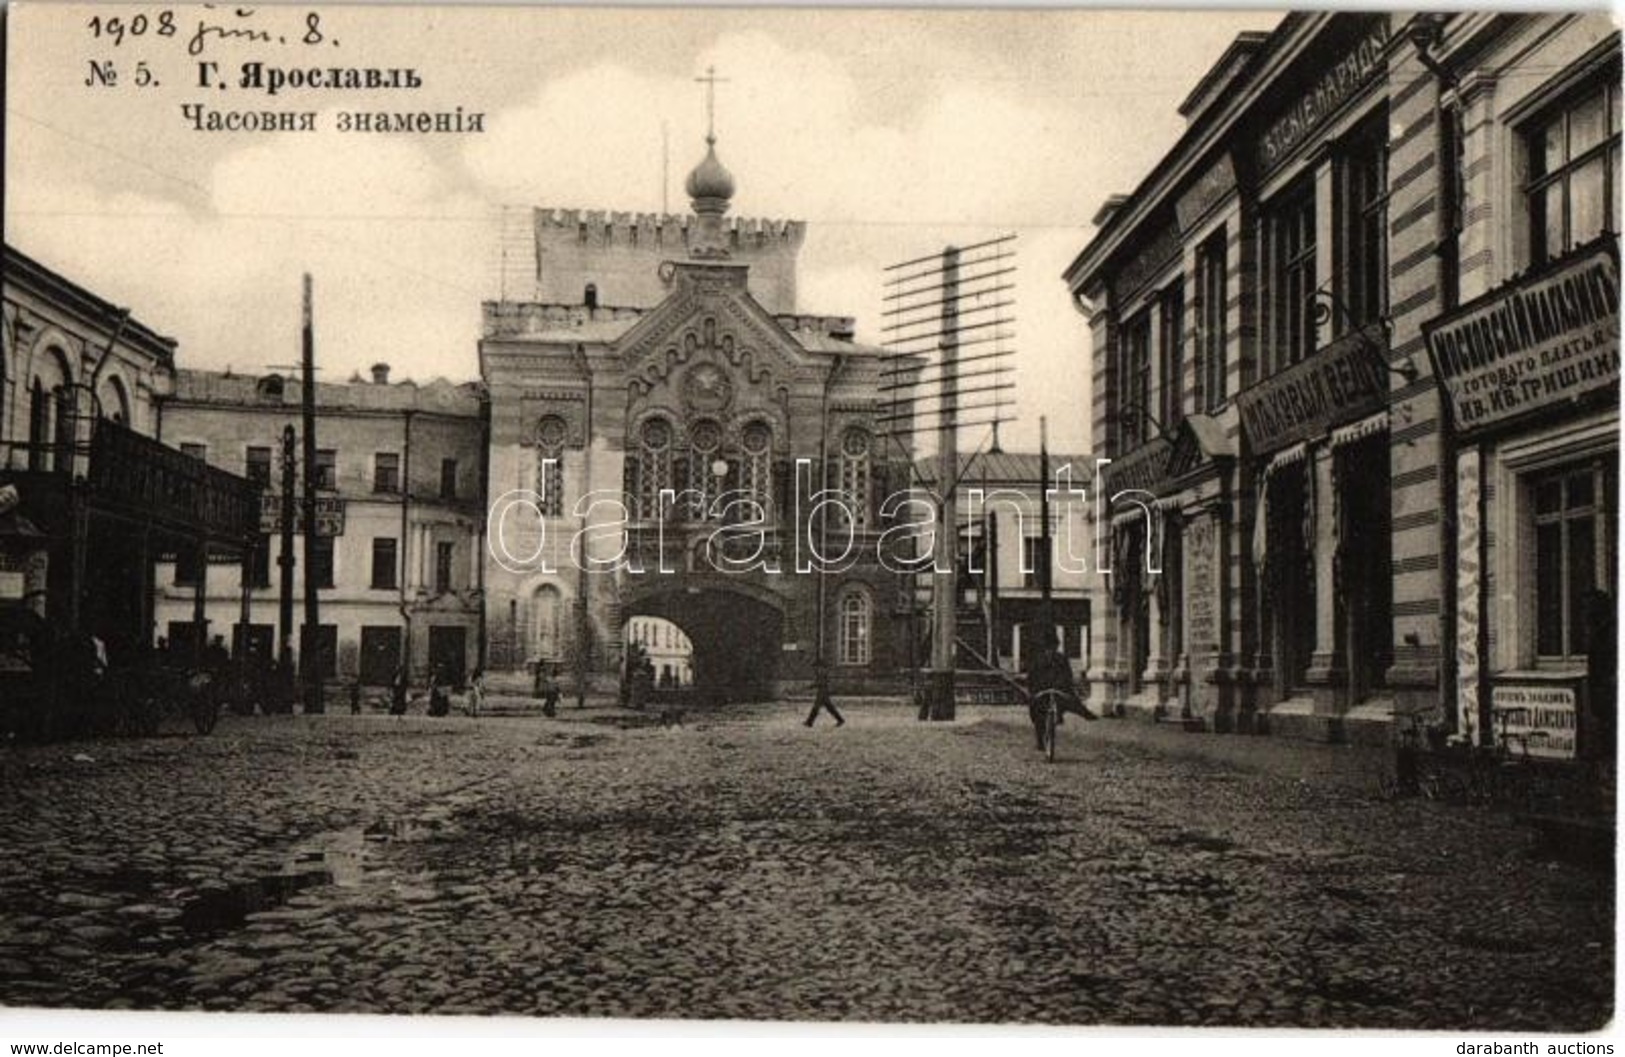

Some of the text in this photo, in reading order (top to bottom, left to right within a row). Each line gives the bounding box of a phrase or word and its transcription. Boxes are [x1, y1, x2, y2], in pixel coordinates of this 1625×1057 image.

[88, 10, 177, 46] 1908
[1433, 290, 1536, 380] МОСКОВСКІЙ
[1463, 330, 1605, 395] ГОТОВАГО ПЛАТЬЯ
